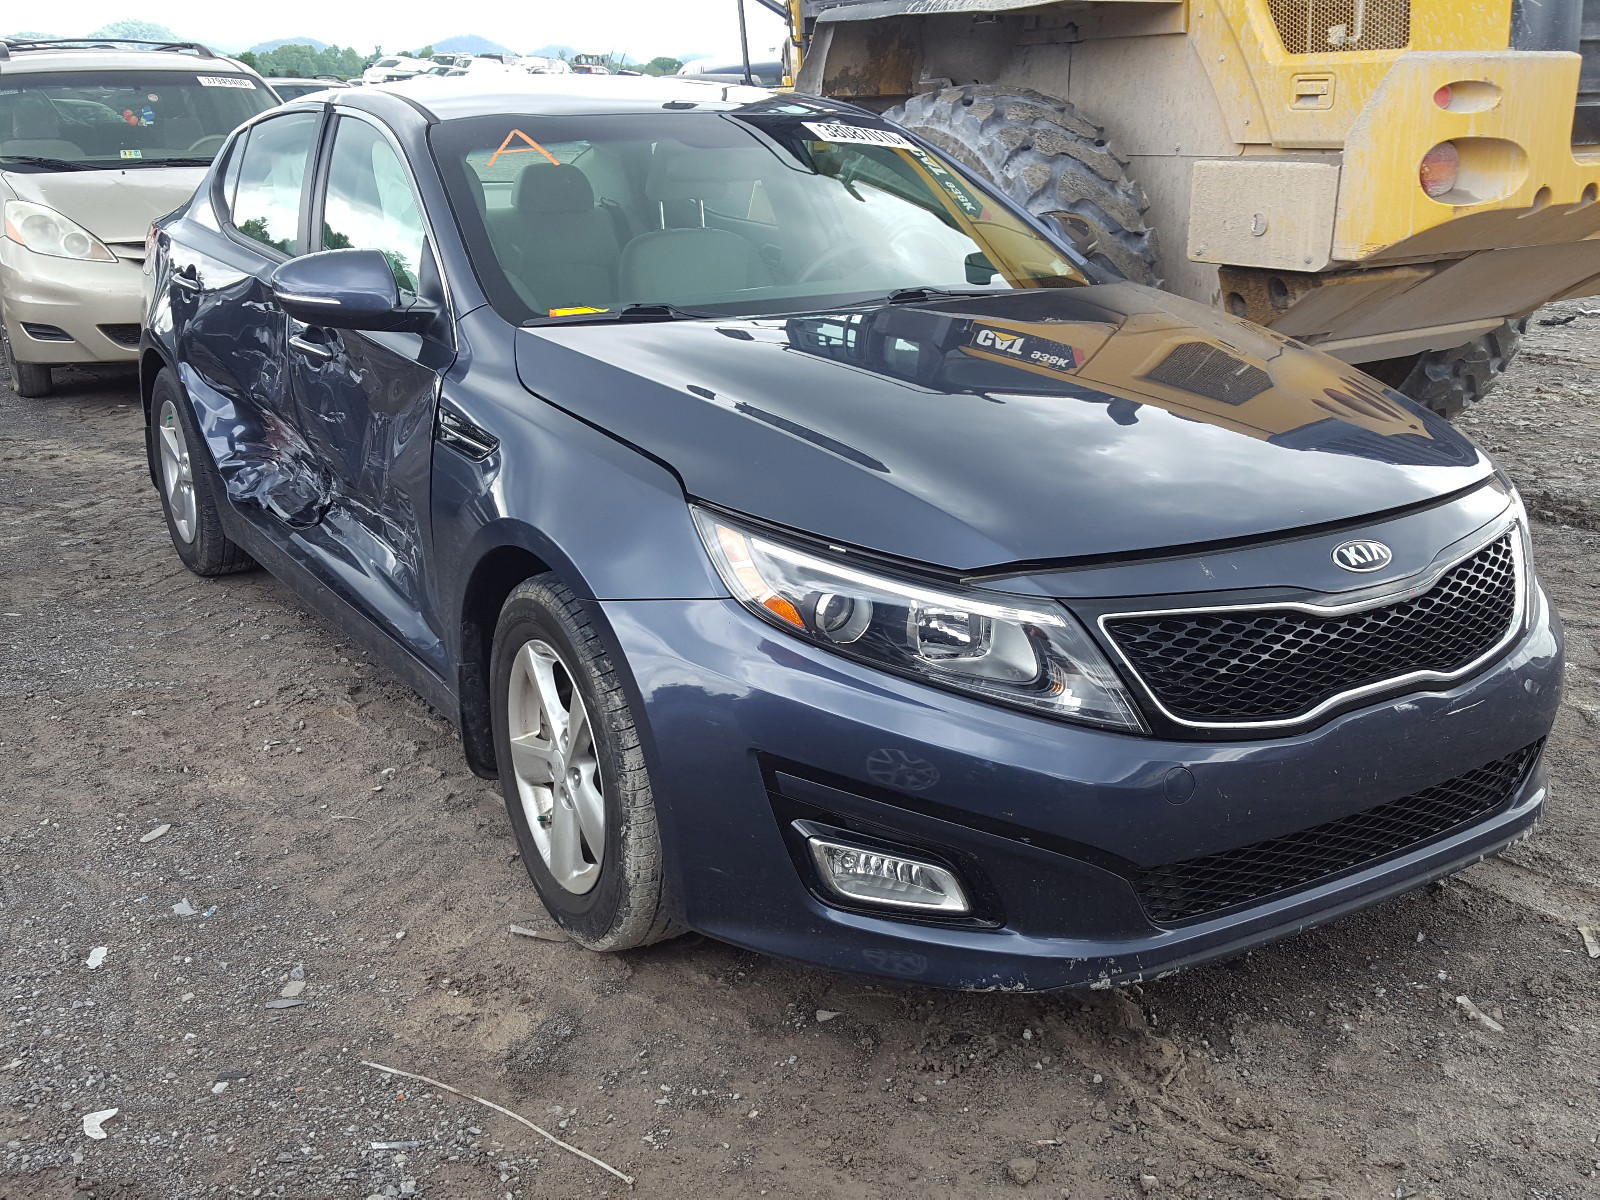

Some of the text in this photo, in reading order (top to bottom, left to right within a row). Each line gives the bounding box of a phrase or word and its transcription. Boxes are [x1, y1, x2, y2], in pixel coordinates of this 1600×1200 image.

[816, 123, 901, 145] 38087010
[486, 128, 561, 167] A
[1339, 542, 1389, 566] KIA
